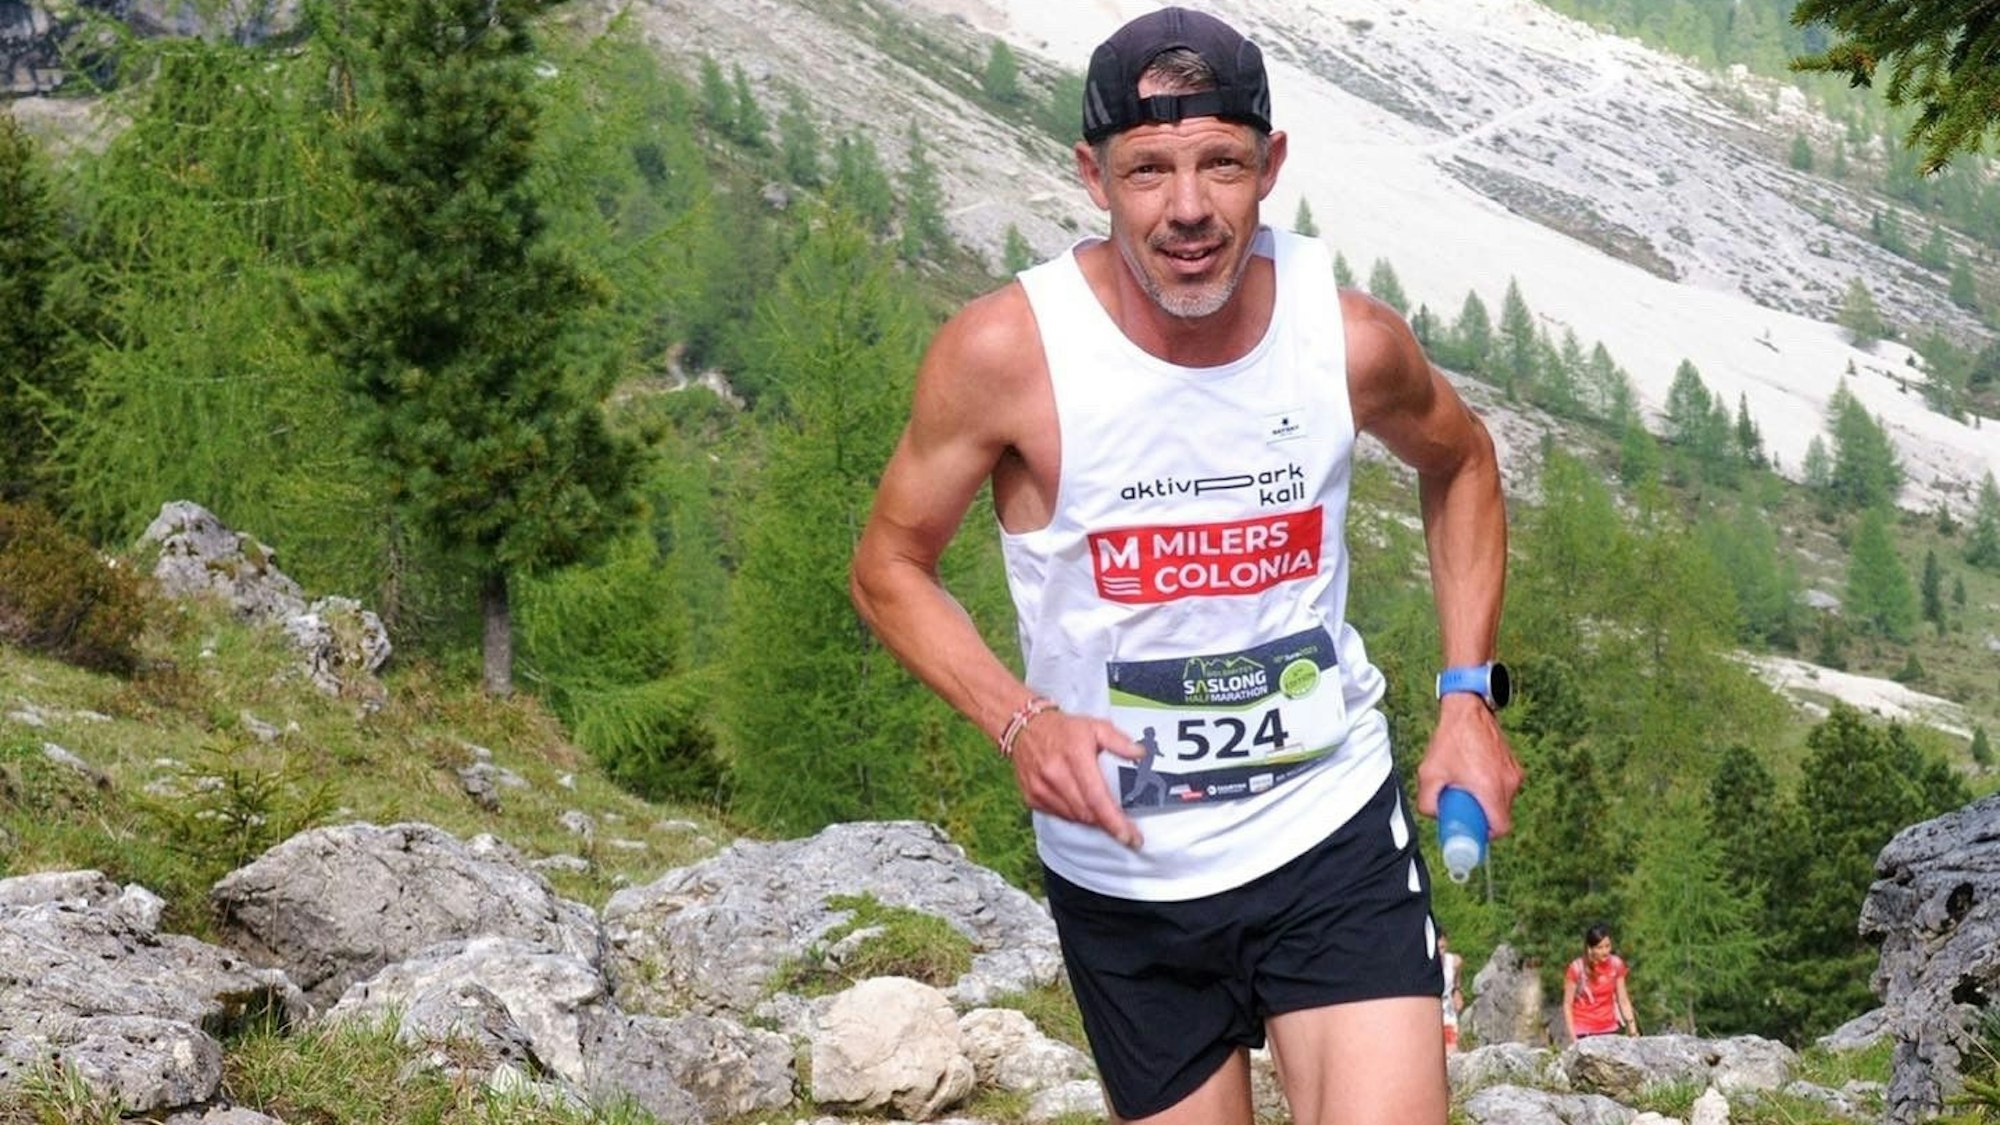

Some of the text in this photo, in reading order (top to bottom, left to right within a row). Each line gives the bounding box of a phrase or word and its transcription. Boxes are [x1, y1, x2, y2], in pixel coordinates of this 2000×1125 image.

[1260, 482, 1305, 506] kall
[1153, 521, 1289, 559] MILERS
[1154, 549, 1313, 593] COLONIA
[1183, 670, 1267, 694] SASLONG
[1177, 708, 1289, 761] 524
